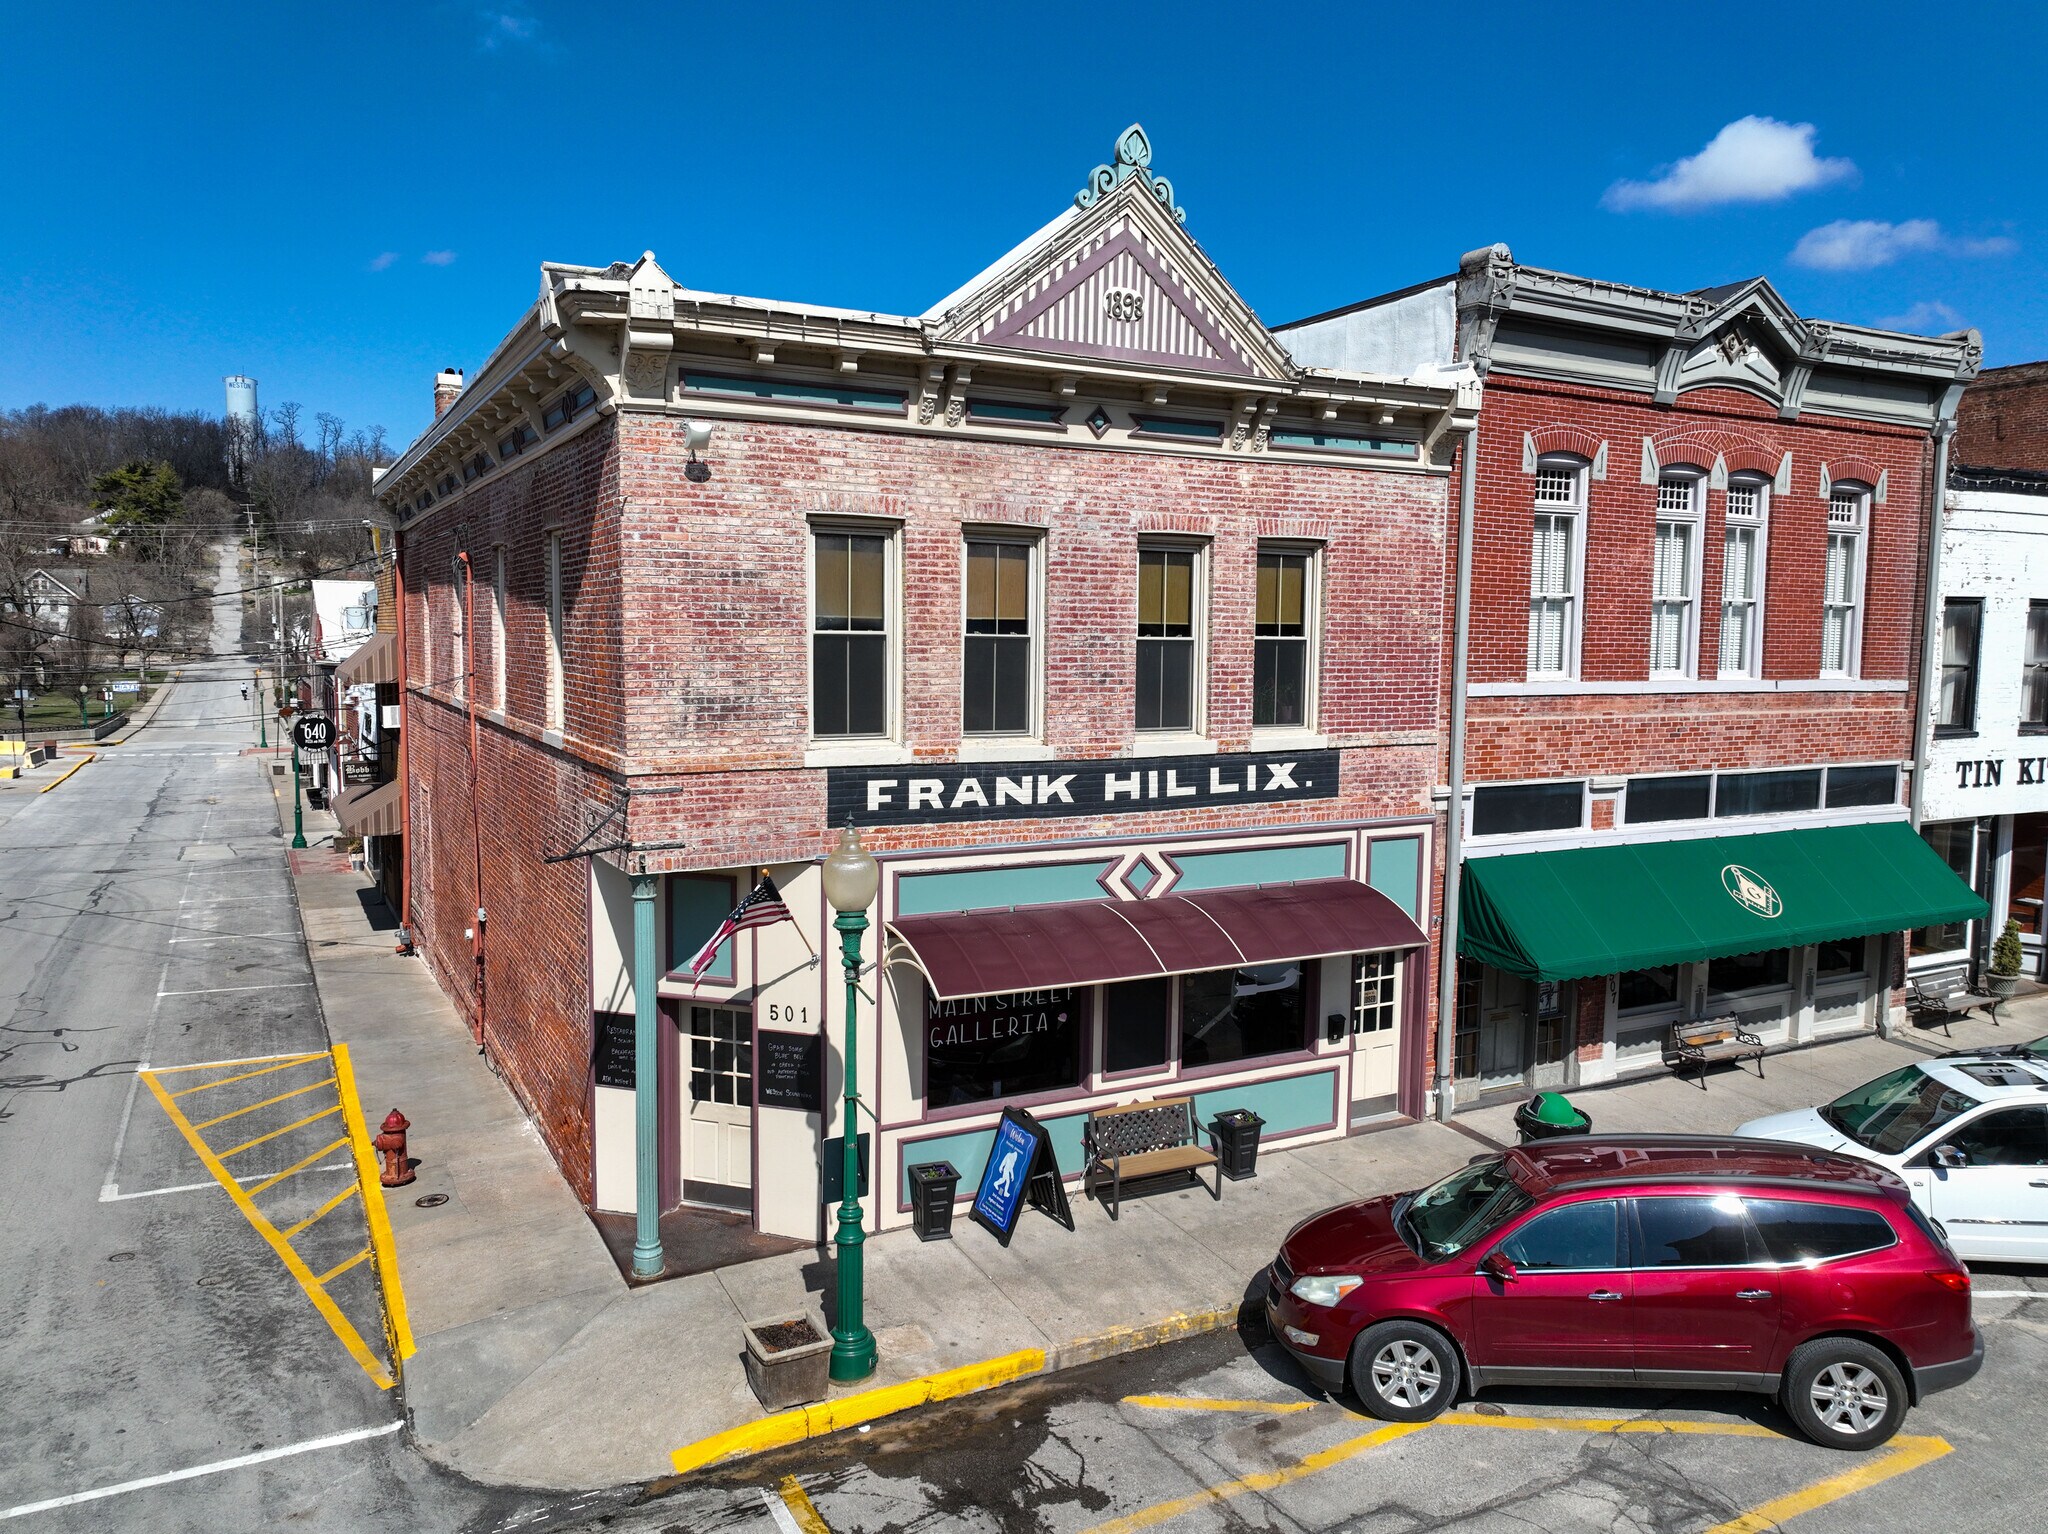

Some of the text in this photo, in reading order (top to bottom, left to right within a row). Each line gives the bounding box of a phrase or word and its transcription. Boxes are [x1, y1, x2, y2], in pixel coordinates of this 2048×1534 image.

[1105, 290, 1144, 322] 1893
[228, 381, 252, 389] WESTON
[304, 722, 327, 739] 640
[1956, 757, 2048, 789] TIN KI
[867, 774, 1078, 811] FRANK
[769, 1004, 807, 1023] 501
[929, 996, 987, 1019] MAIN
[930, 1012, 1048, 1047] GALLERIA
